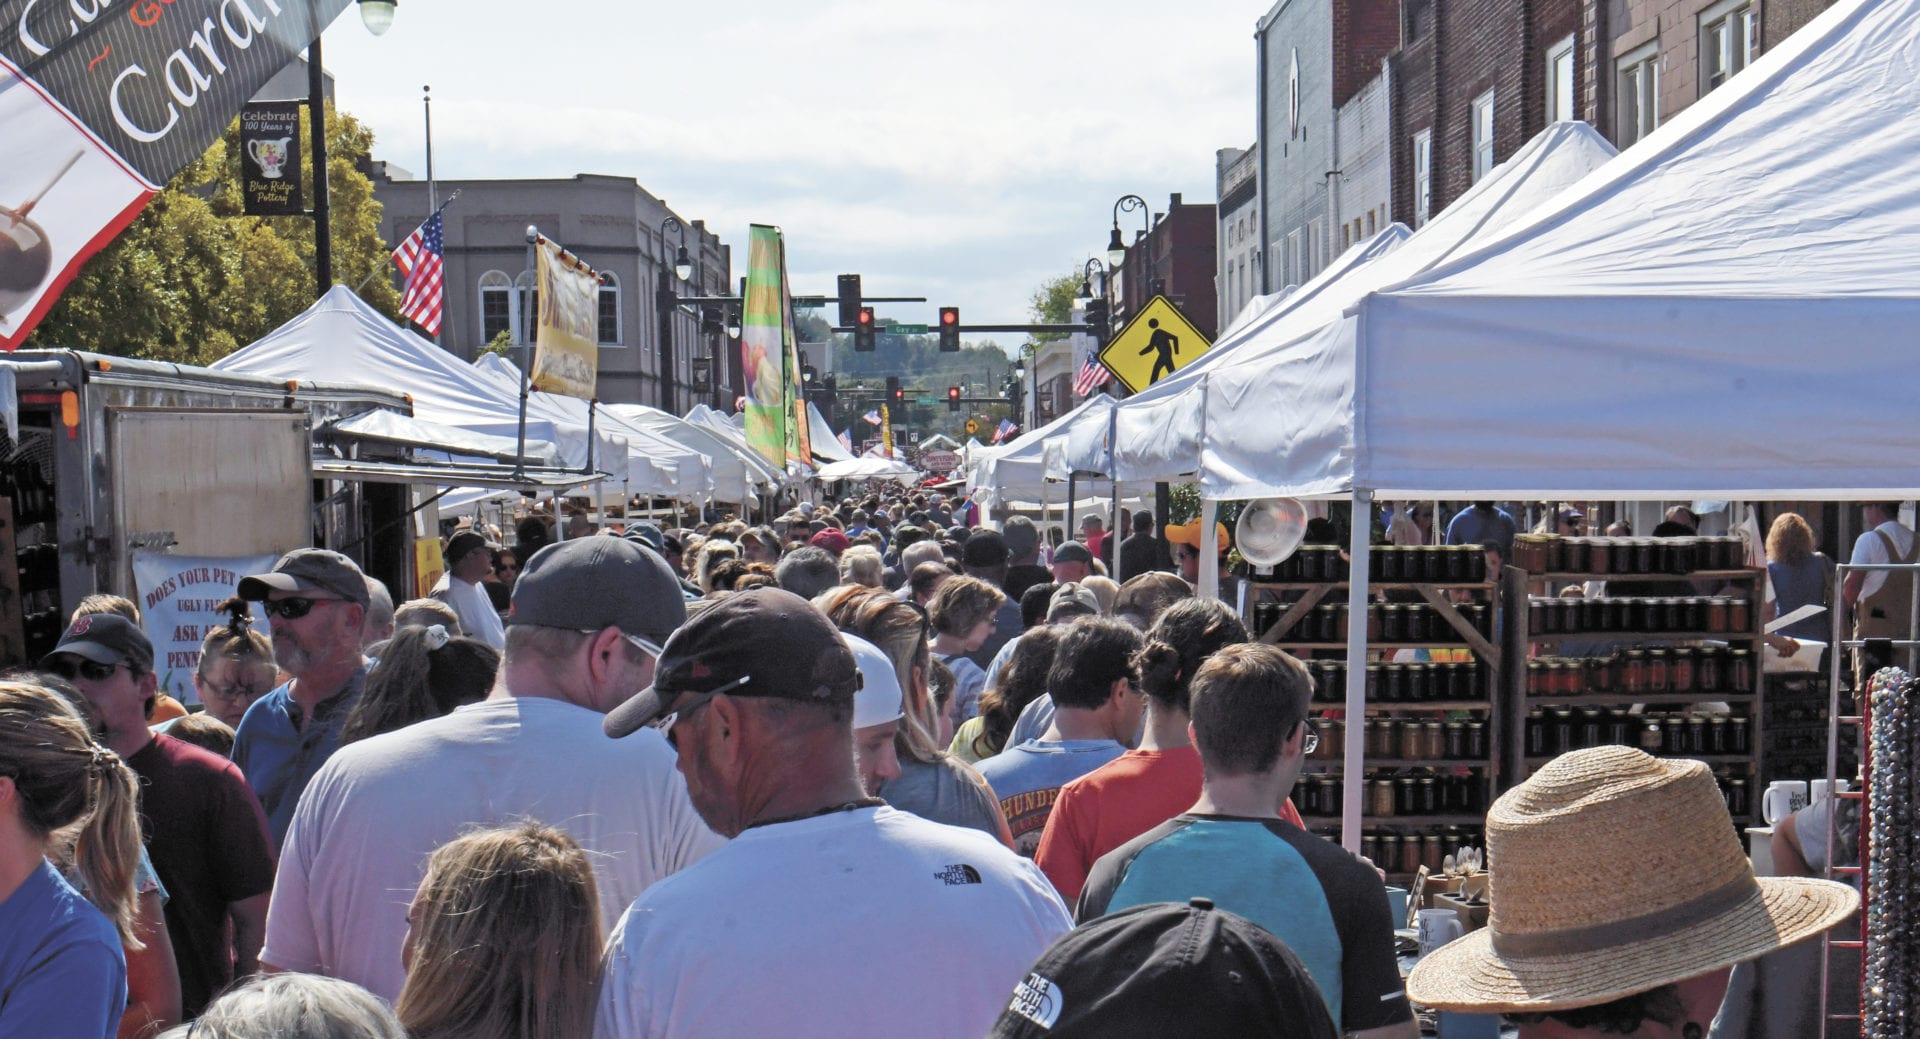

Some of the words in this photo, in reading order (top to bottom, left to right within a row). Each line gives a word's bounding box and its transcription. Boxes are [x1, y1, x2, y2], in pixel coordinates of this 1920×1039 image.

[109, 0, 282, 143] Cara
[242, 111, 298, 121] Celebrate
[245, 121, 259, 130] 100
[261, 122, 283, 131] Years
[285, 122, 294, 135] of
[249, 180, 270, 192] Blue
[271, 180, 295, 195] Ridge
[257, 192, 288, 206] Pottery
[146, 577, 177, 609] DOES
[178, 567, 210, 588] YOUR
[213, 567, 236, 586] PET
[177, 599, 201, 612] UGLY
[172, 624, 199, 641] ASK
[167, 651, 201, 669] PENN
[1001, 788, 1058, 820] HUNDE
[933, 871, 965, 880] NORTH
[944, 864, 962, 873] THE
[944, 878, 967, 886] FACE
[1028, 972, 1050, 993] THE
